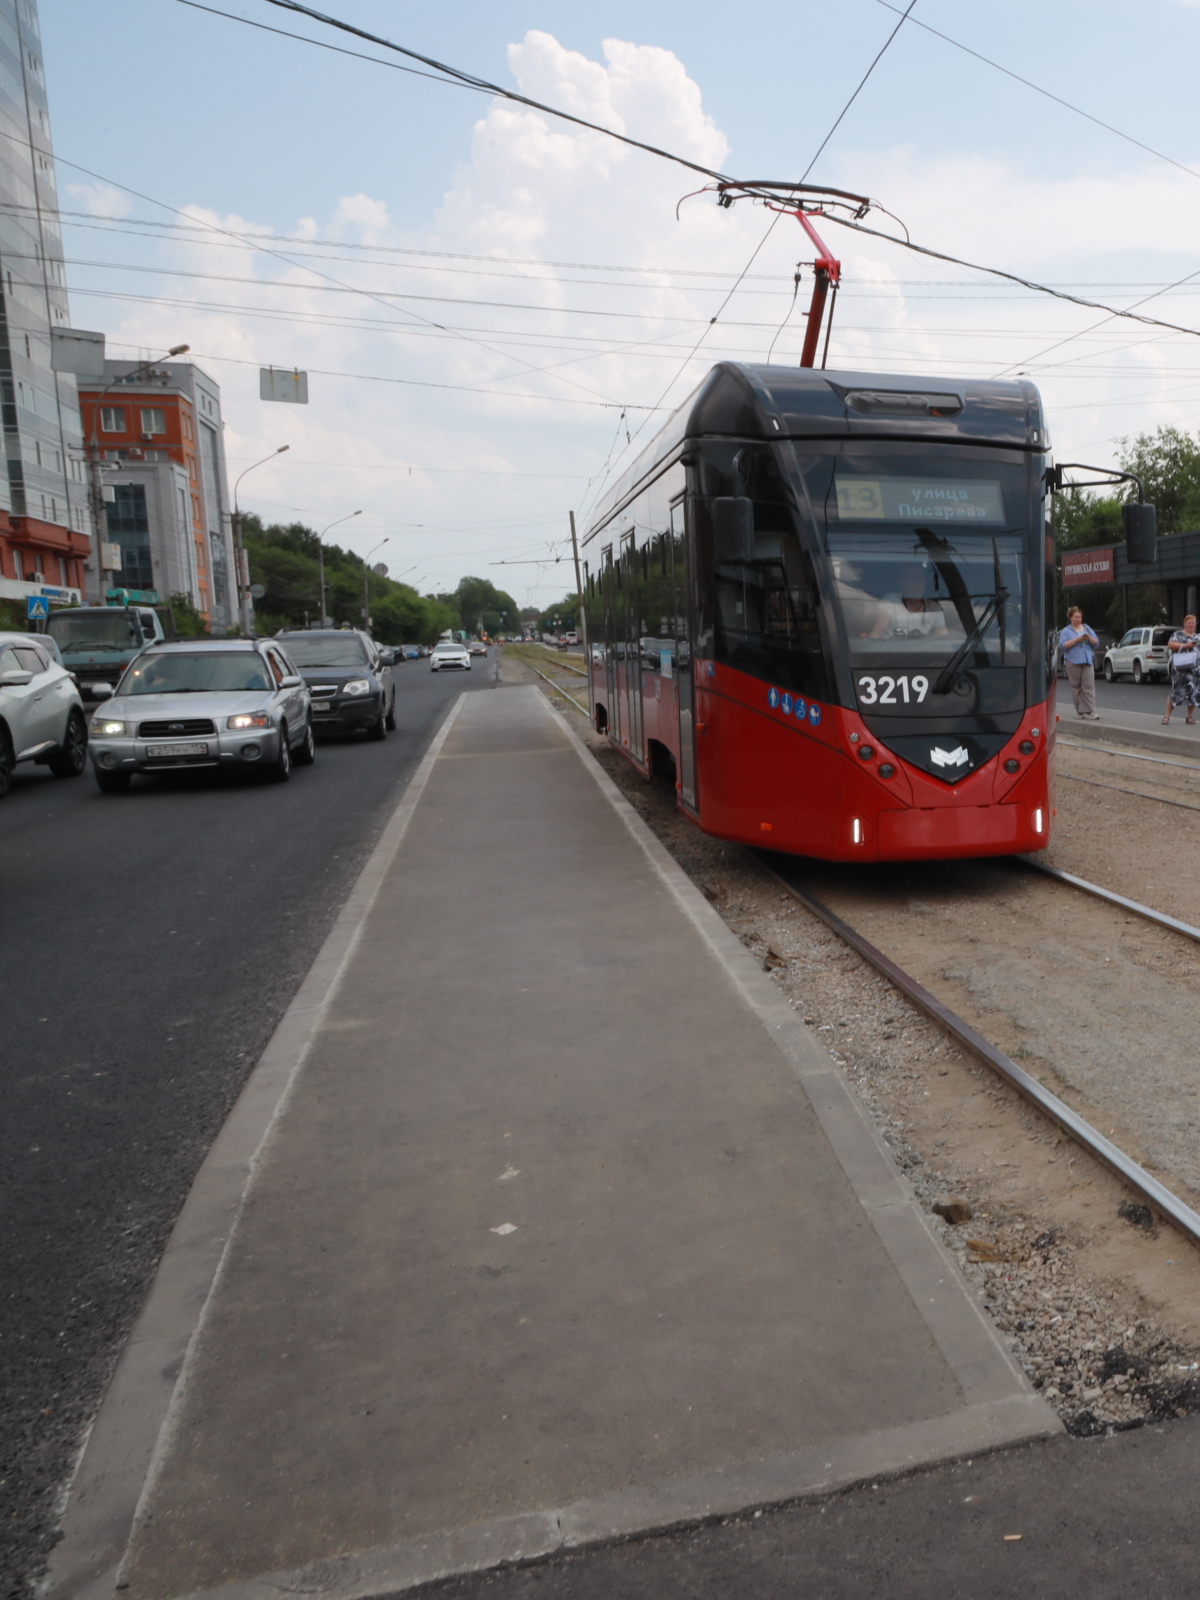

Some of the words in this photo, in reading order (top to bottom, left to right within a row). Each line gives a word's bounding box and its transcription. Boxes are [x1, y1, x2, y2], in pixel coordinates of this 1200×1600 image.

[838, 487, 879, 512] 13
[911, 488, 968, 502] улица
[898, 503, 986, 520] Писарева
[858, 675, 929, 705] 3219
